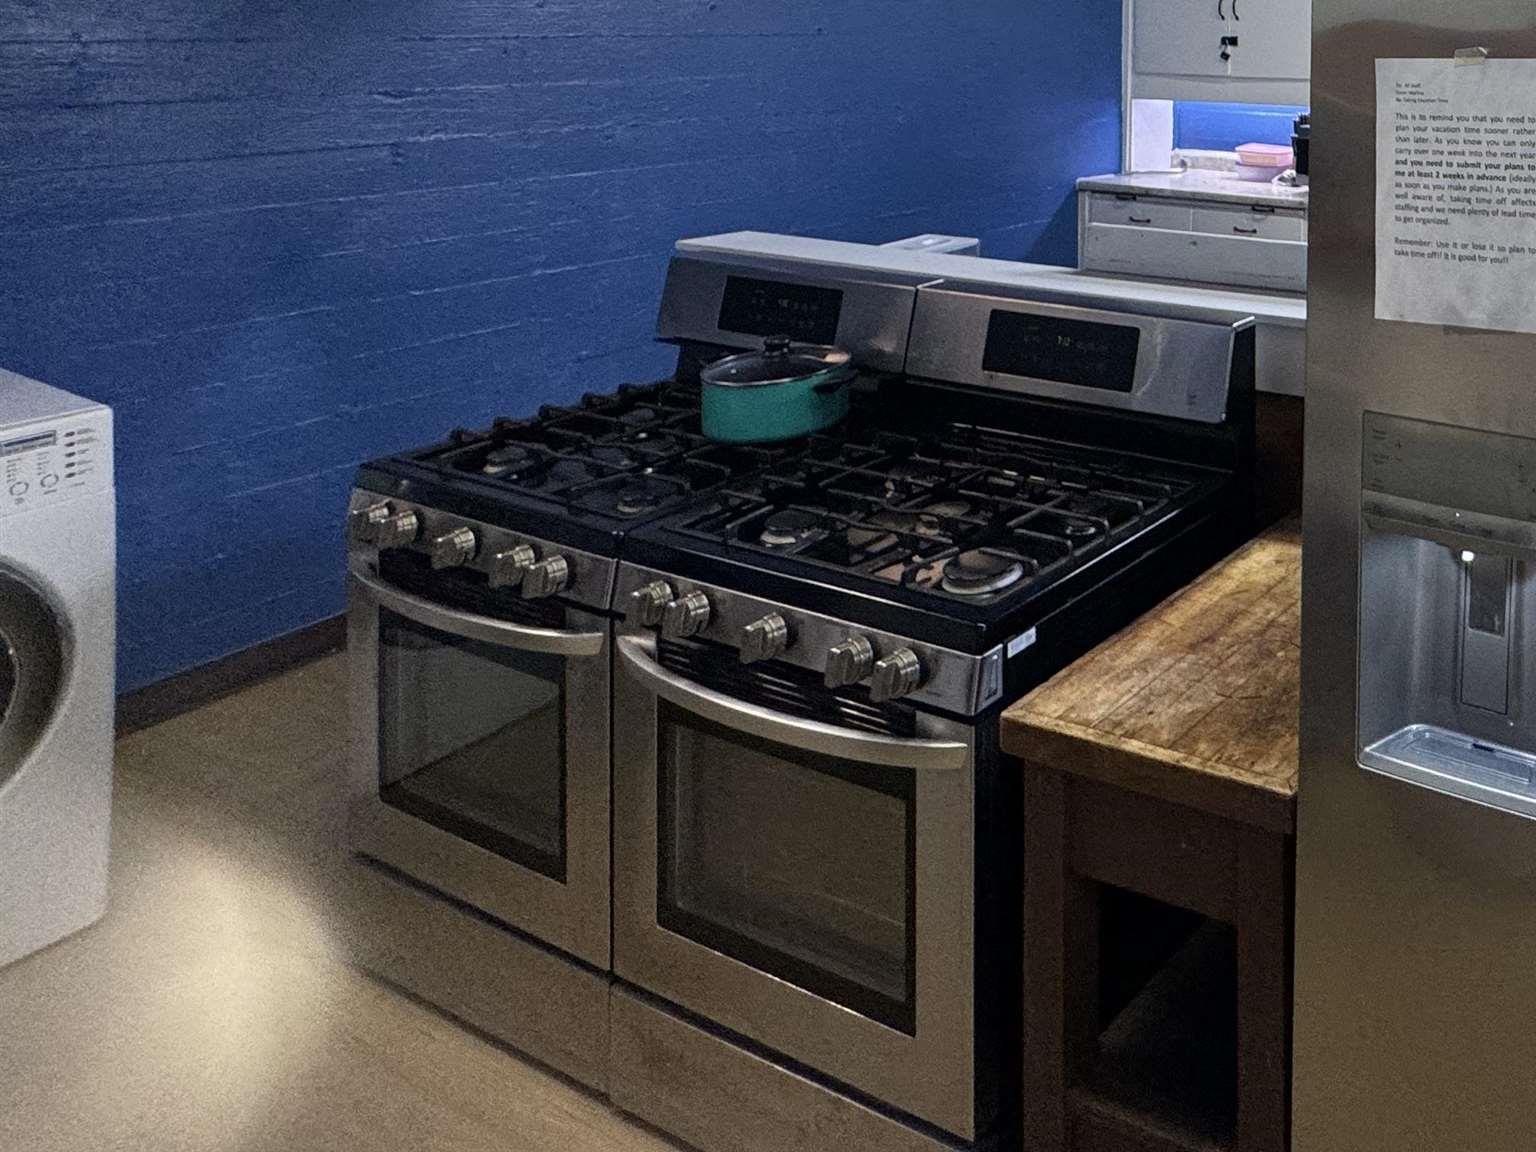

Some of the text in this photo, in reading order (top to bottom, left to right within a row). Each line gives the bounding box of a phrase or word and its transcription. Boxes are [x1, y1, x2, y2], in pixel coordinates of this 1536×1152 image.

[1429, 113, 1454, 122] remind
[1456, 115, 1470, 123] you
[1489, 116, 1504, 125] you
[1506, 115, 1525, 124] need
[1528, 116, 1536, 124] to
[1432, 125, 1461, 134] vacation
[1464, 126, 1481, 135] time
[1512, 127, 1536, 136] rather
[1434, 136, 1443, 145] As
[1446, 138, 1460, 147] you
[1463, 138, 1482, 146] know
[1486, 139, 1500, 148] you
[1520, 139, 1536, 148] only
[1486, 149, 1498, 158] the
[1500, 151, 1517, 159] next
[1394, 158, 1536, 172] and you need to submit your plans to
[1408, 170, 1415, 178] at
[1416, 170, 1434, 179] least
[1442, 172, 1465, 180] weeks
[1466, 173, 1475, 181] in
[1476, 173, 1507, 182] advance
[1432, 184, 1446, 192] you
[1448, 183, 1467, 192] make
[1495, 186, 1505, 194] As
[1506, 187, 1521, 196] you
[1412, 194, 1433, 202] aware
[1450, 194, 1472, 206] taking
[1475, 196, 1492, 205] time
[1496, 196, 1508, 205] off
[1511, 198, 1536, 207] affects
[1420, 204, 1434, 214] and
[1434, 206, 1446, 214] we
[1448, 206, 1466, 216] need
[1467, 208, 1490, 218] plenty
[1491, 208, 1499, 217] of
[1501, 209, 1517, 218] lead
[1518, 210, 1536, 219] time
[1403, 216, 1414, 225] get
[1460, 242, 1470, 250] or
[1472, 242, 1487, 251] lose
[1508, 244, 1526, 254] plan
[1528, 246, 1536, 255] to
[1458, 252, 1477, 263] good
[1478, 254, 1488, 263] for
